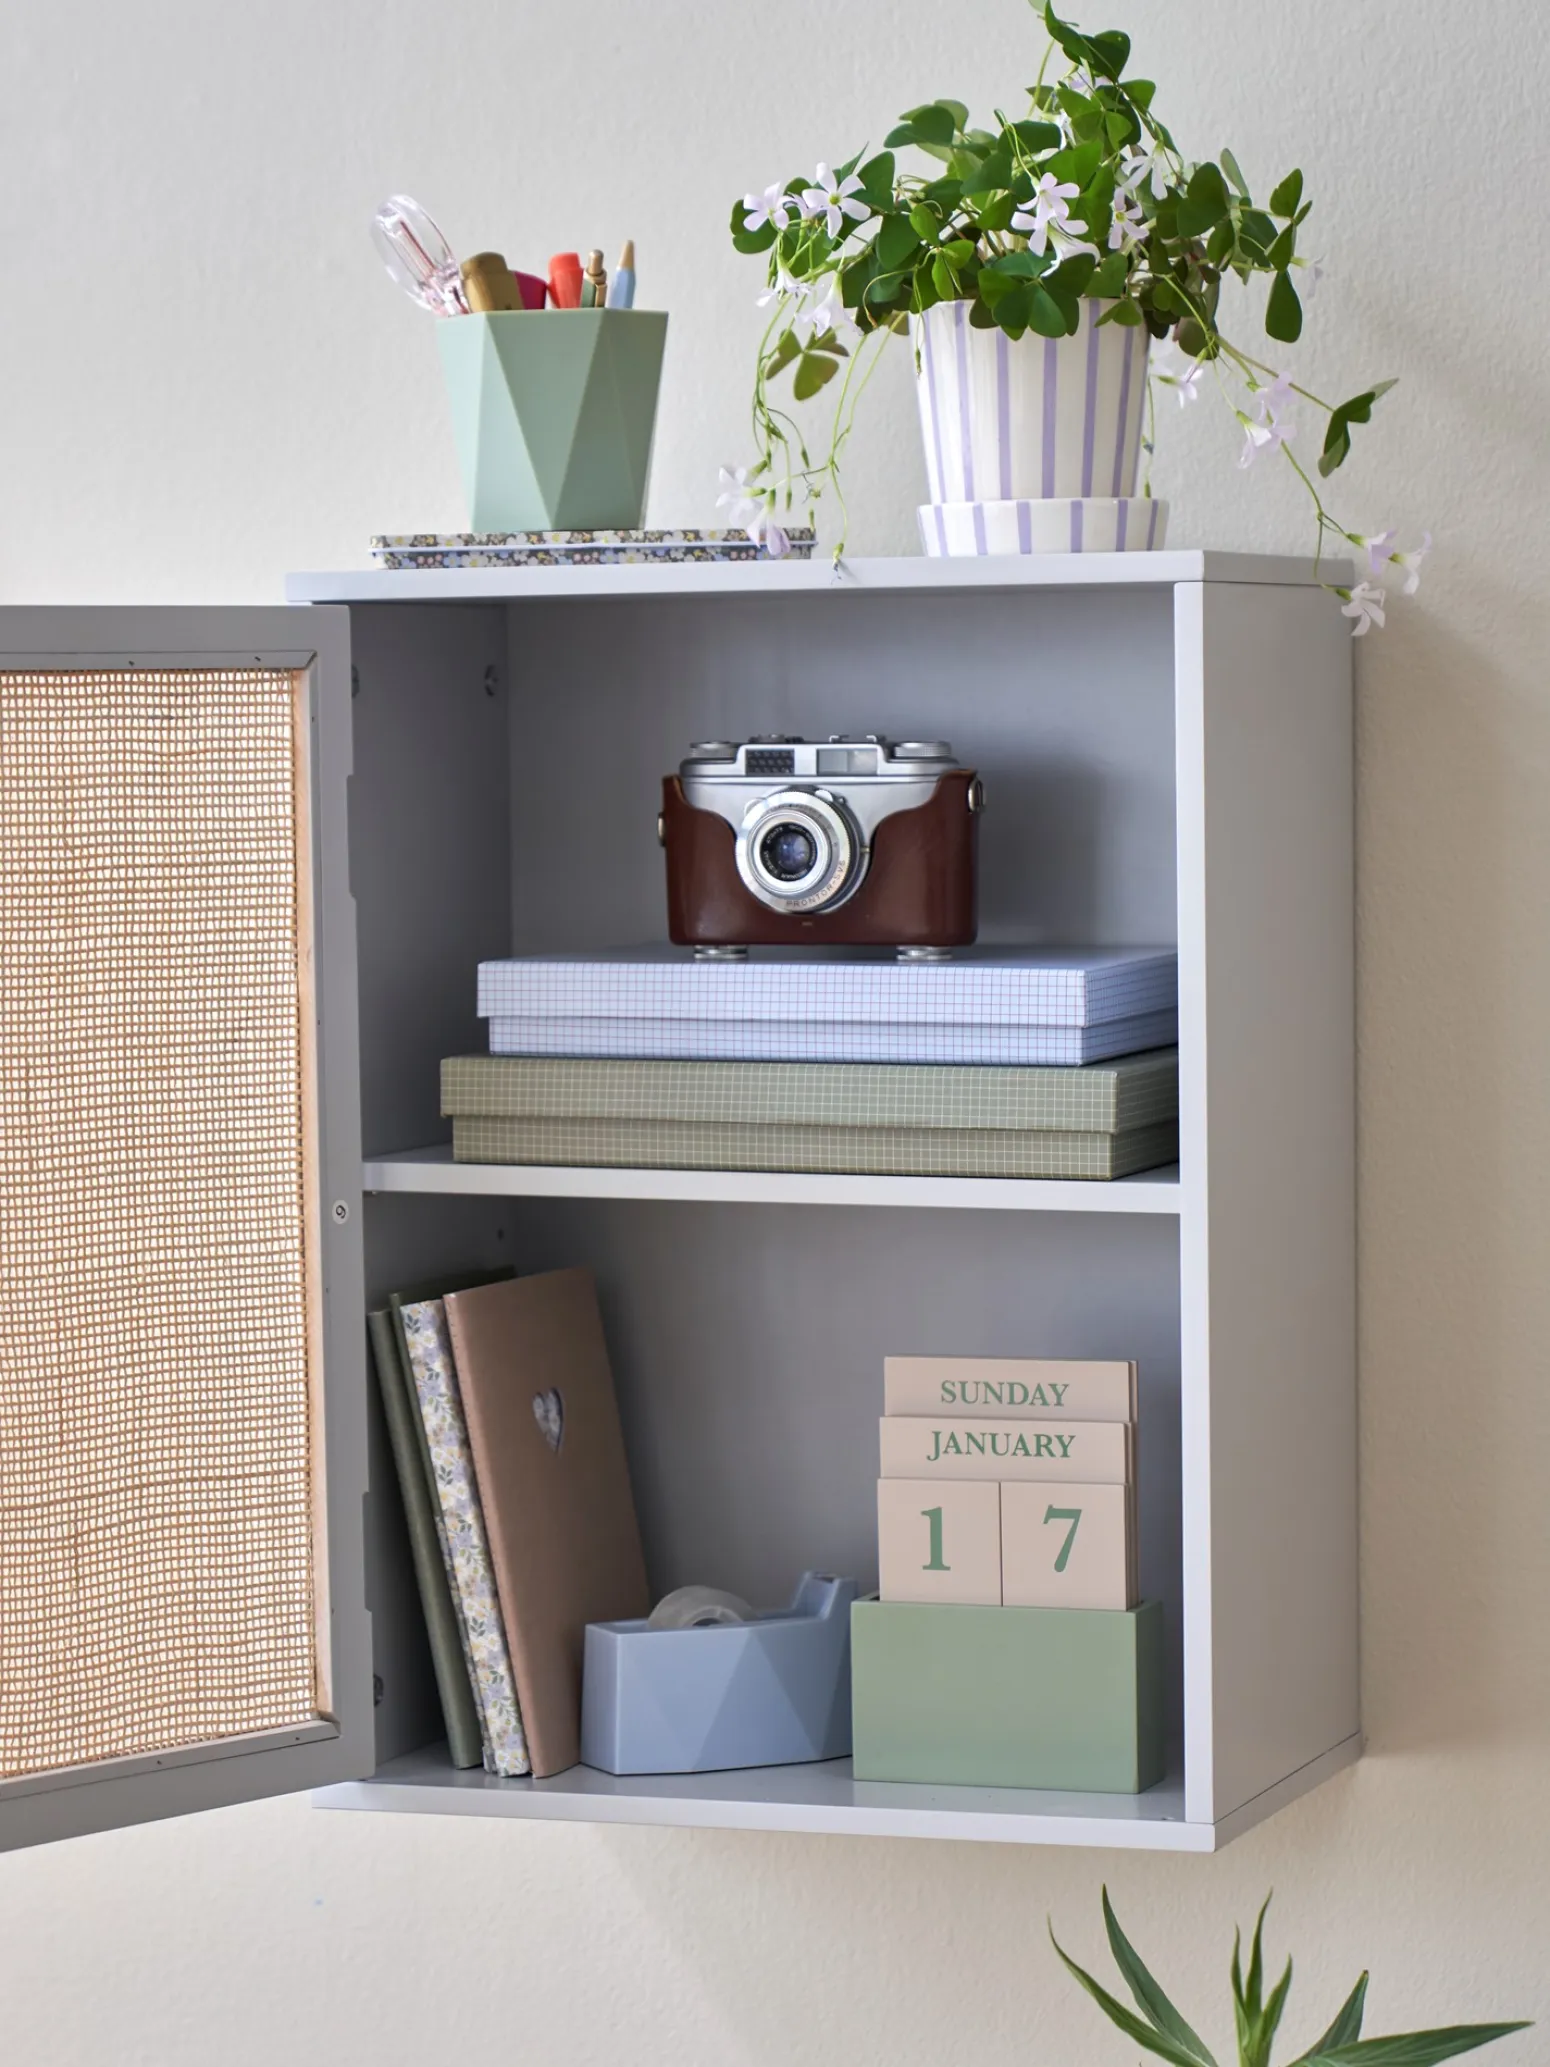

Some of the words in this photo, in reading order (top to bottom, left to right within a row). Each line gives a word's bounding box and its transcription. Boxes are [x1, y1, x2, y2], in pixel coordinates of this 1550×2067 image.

[941, 1380, 1070, 1407] SUNDAY
[927, 1431, 1075, 1461] JANUARY
[921, 1507, 951, 1571] 1
[1043, 1505, 1082, 1573] 7
